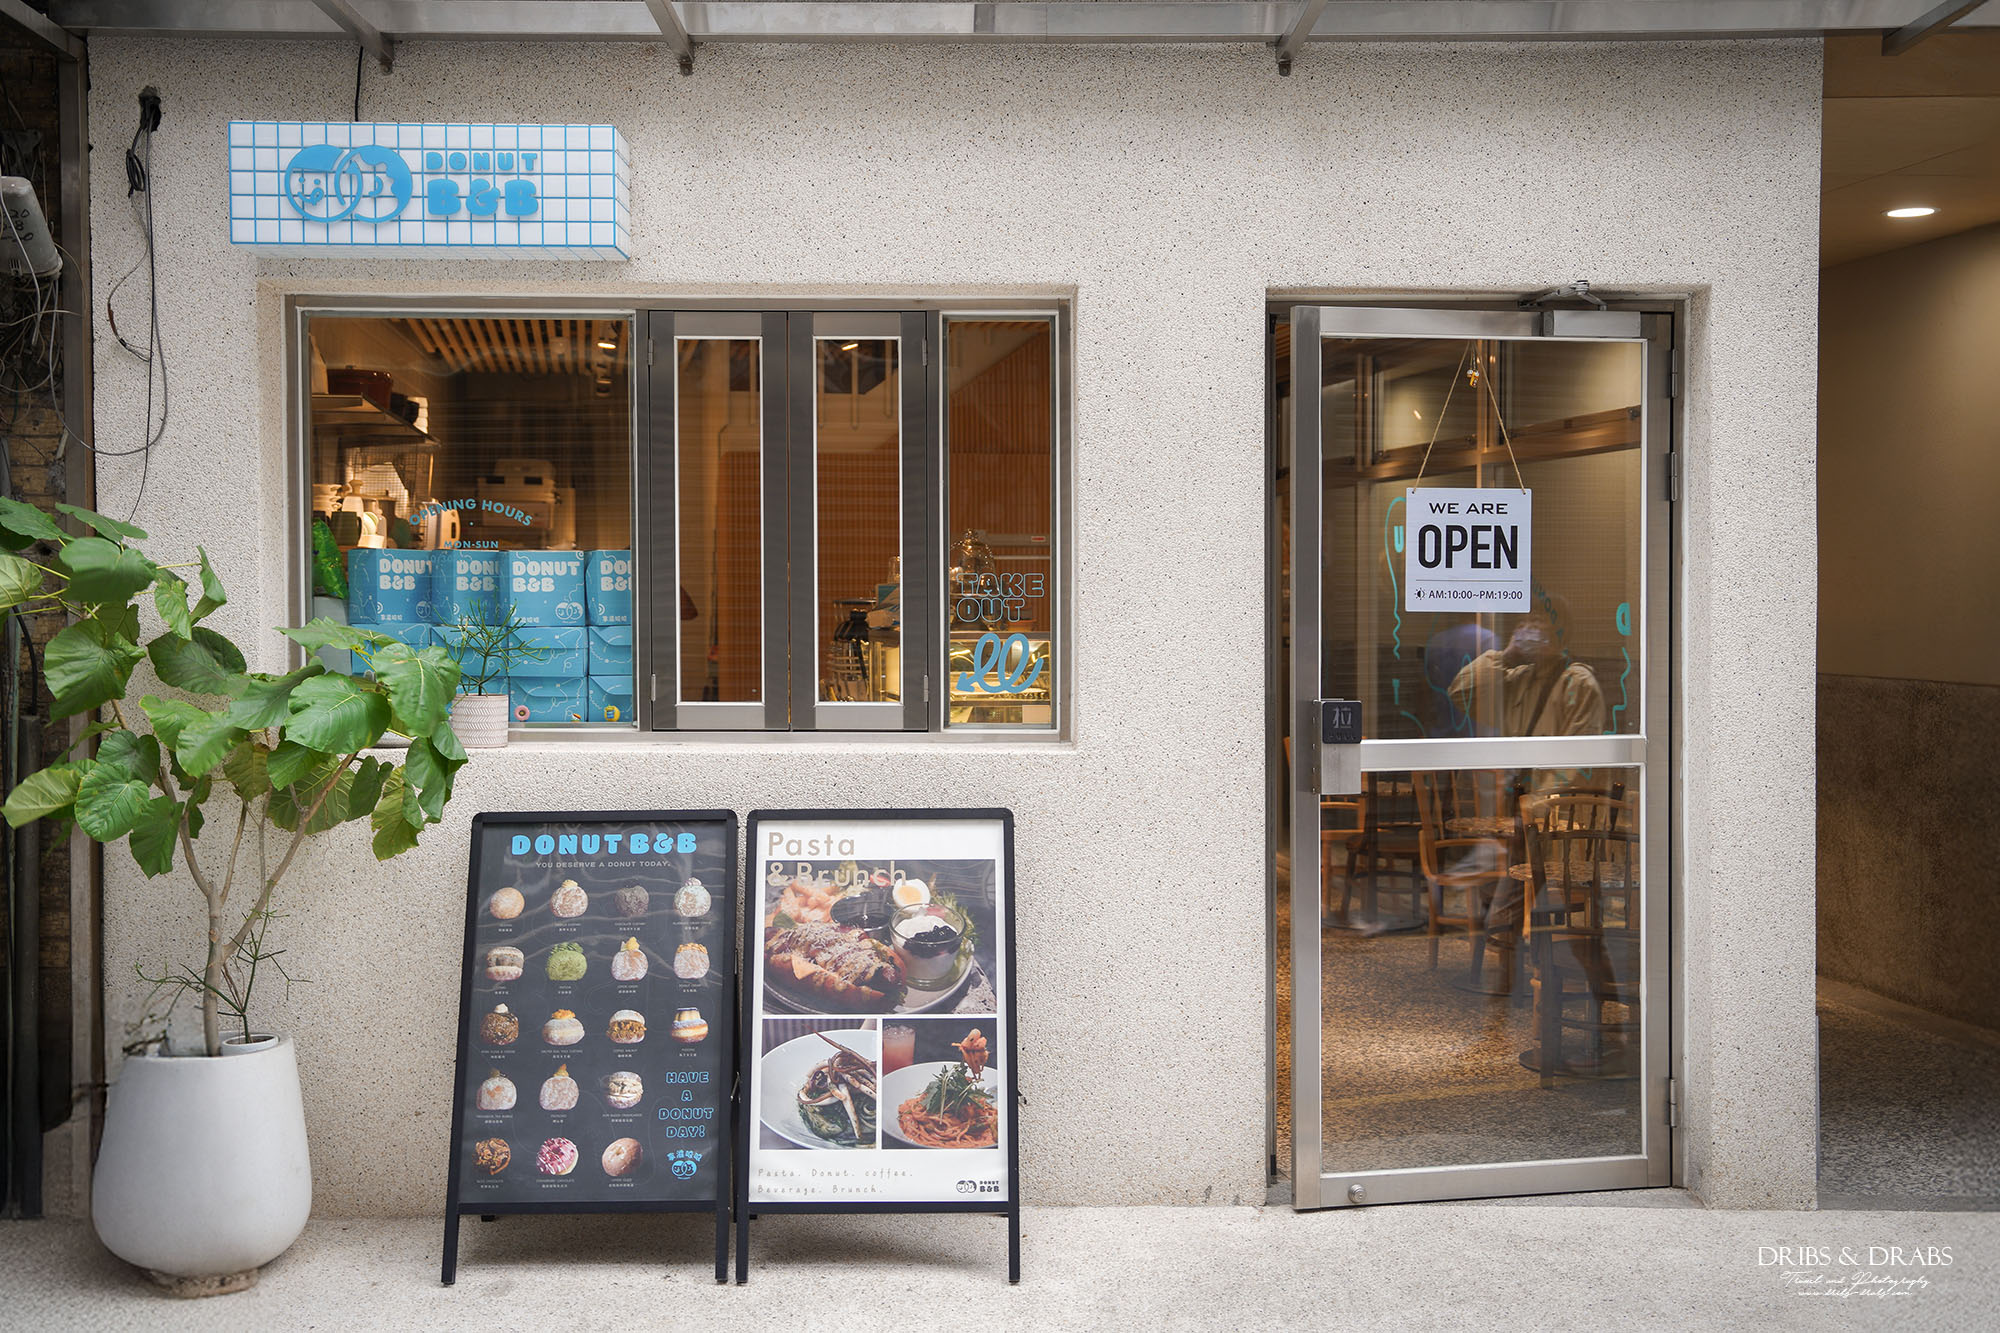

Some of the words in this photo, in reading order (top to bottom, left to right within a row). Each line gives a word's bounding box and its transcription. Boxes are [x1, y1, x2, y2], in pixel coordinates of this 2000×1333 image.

[426, 152, 538, 171] DONUT
[427, 178, 539, 217] B&B
[409, 498, 477, 526] OPENING
[481, 499, 534, 527] HOURS
[1428, 502, 1459, 514] WE
[1465, 503, 1508, 515] ARE
[443, 540, 499, 550] MON-SUN
[1418, 524, 1518, 569] OPEN
[512, 561, 580, 576] DONUT
[600, 560, 631, 575] DO
[379, 575, 416, 590] B&B
[456, 576, 495, 591] B&B
[512, 577, 555, 592] B&B
[600, 576, 631, 592] B&
[956, 572, 1045, 598] TAKE
[1428, 590, 1523, 600] AM:10:00~PM:19:00
[956, 597, 1025, 622] OUT
[1332, 705, 1352, 729] 拉
[511, 834, 623, 856] DONUT
[630, 832, 697, 854] B&B
[768, 831, 856, 857] Pasta
[536, 861, 554, 869] YOU
[767, 862, 789, 887] &
[796, 860, 907, 888] Brunch
[665, 1071, 710, 1084] HAVE
[681, 1090, 693, 1101] A
[658, 1107, 714, 1120] DONUT
[666, 1125, 706, 1138] DAY!
[979, 1185, 1000, 1193] B&B
